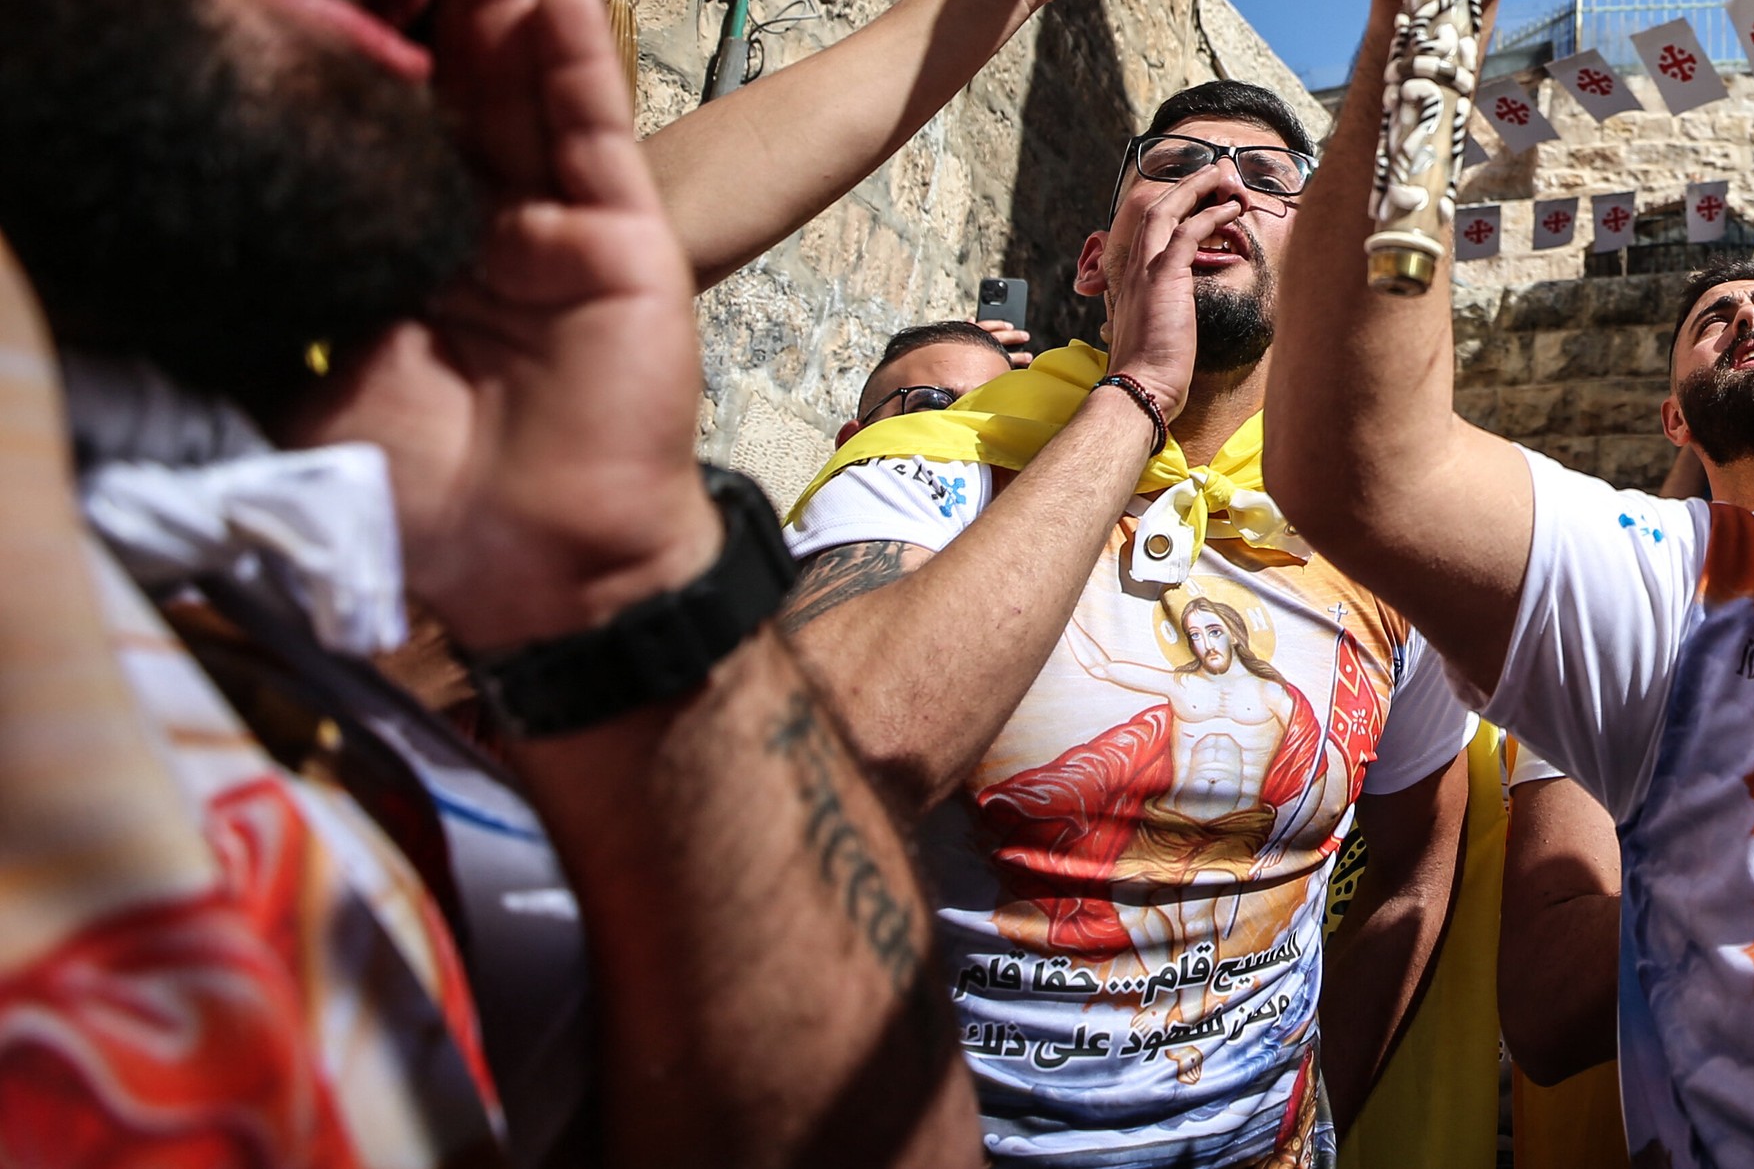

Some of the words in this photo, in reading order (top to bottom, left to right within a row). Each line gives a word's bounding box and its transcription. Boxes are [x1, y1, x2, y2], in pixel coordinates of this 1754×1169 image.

[953, 949, 1024, 1000] قام
[1032, 957, 1099, 995] حقا
[1213, 929, 1302, 994] المسيح
[961, 1020, 1028, 1059] ذلك
[1033, 1023, 1111, 1070] على
